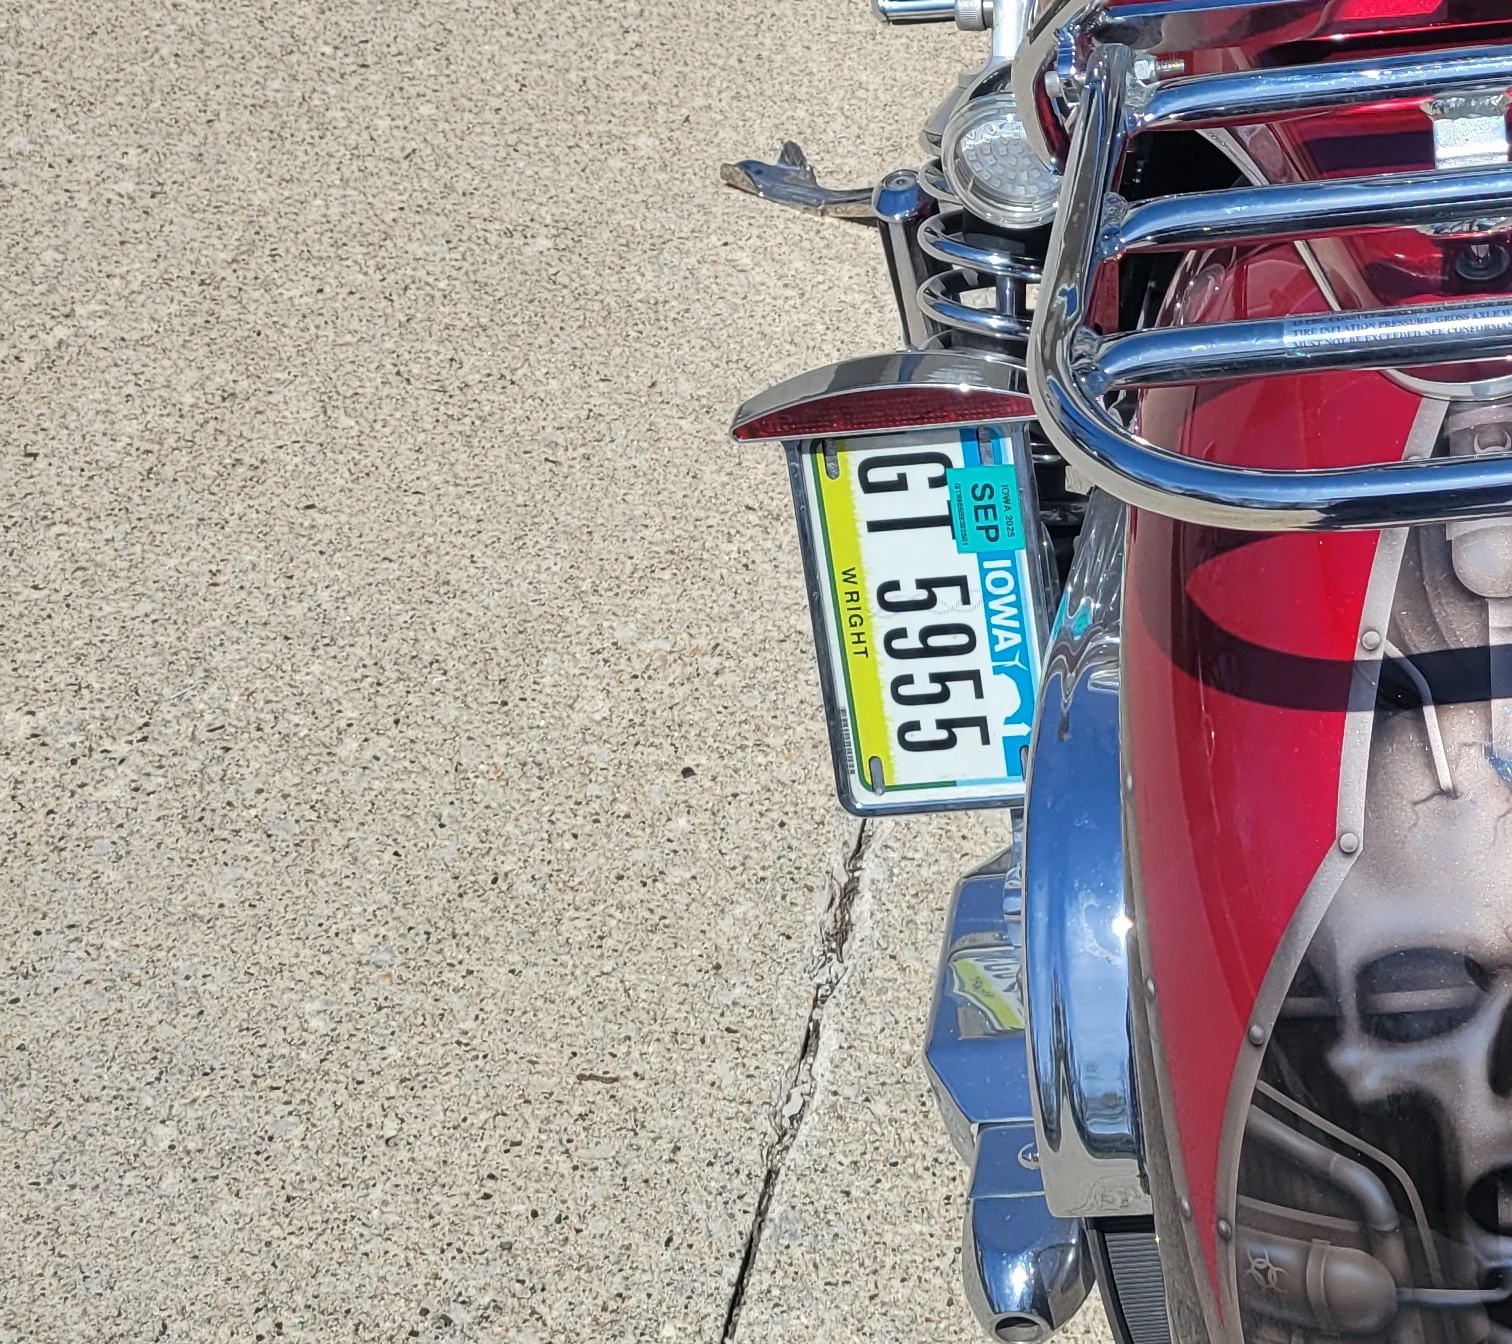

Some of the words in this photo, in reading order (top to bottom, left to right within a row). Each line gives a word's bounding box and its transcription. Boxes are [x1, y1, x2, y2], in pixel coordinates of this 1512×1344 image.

[1292, 327, 1318, 337] TIRE
[970, 482, 999, 543] SEP
[1000, 484, 1012, 513] IOWA
[1004, 514, 1015, 538] 2025
[841, 567, 870, 658] WRIGHT
[983, 559, 1019, 653] IOWA
[877, 575, 992, 753] 5955
